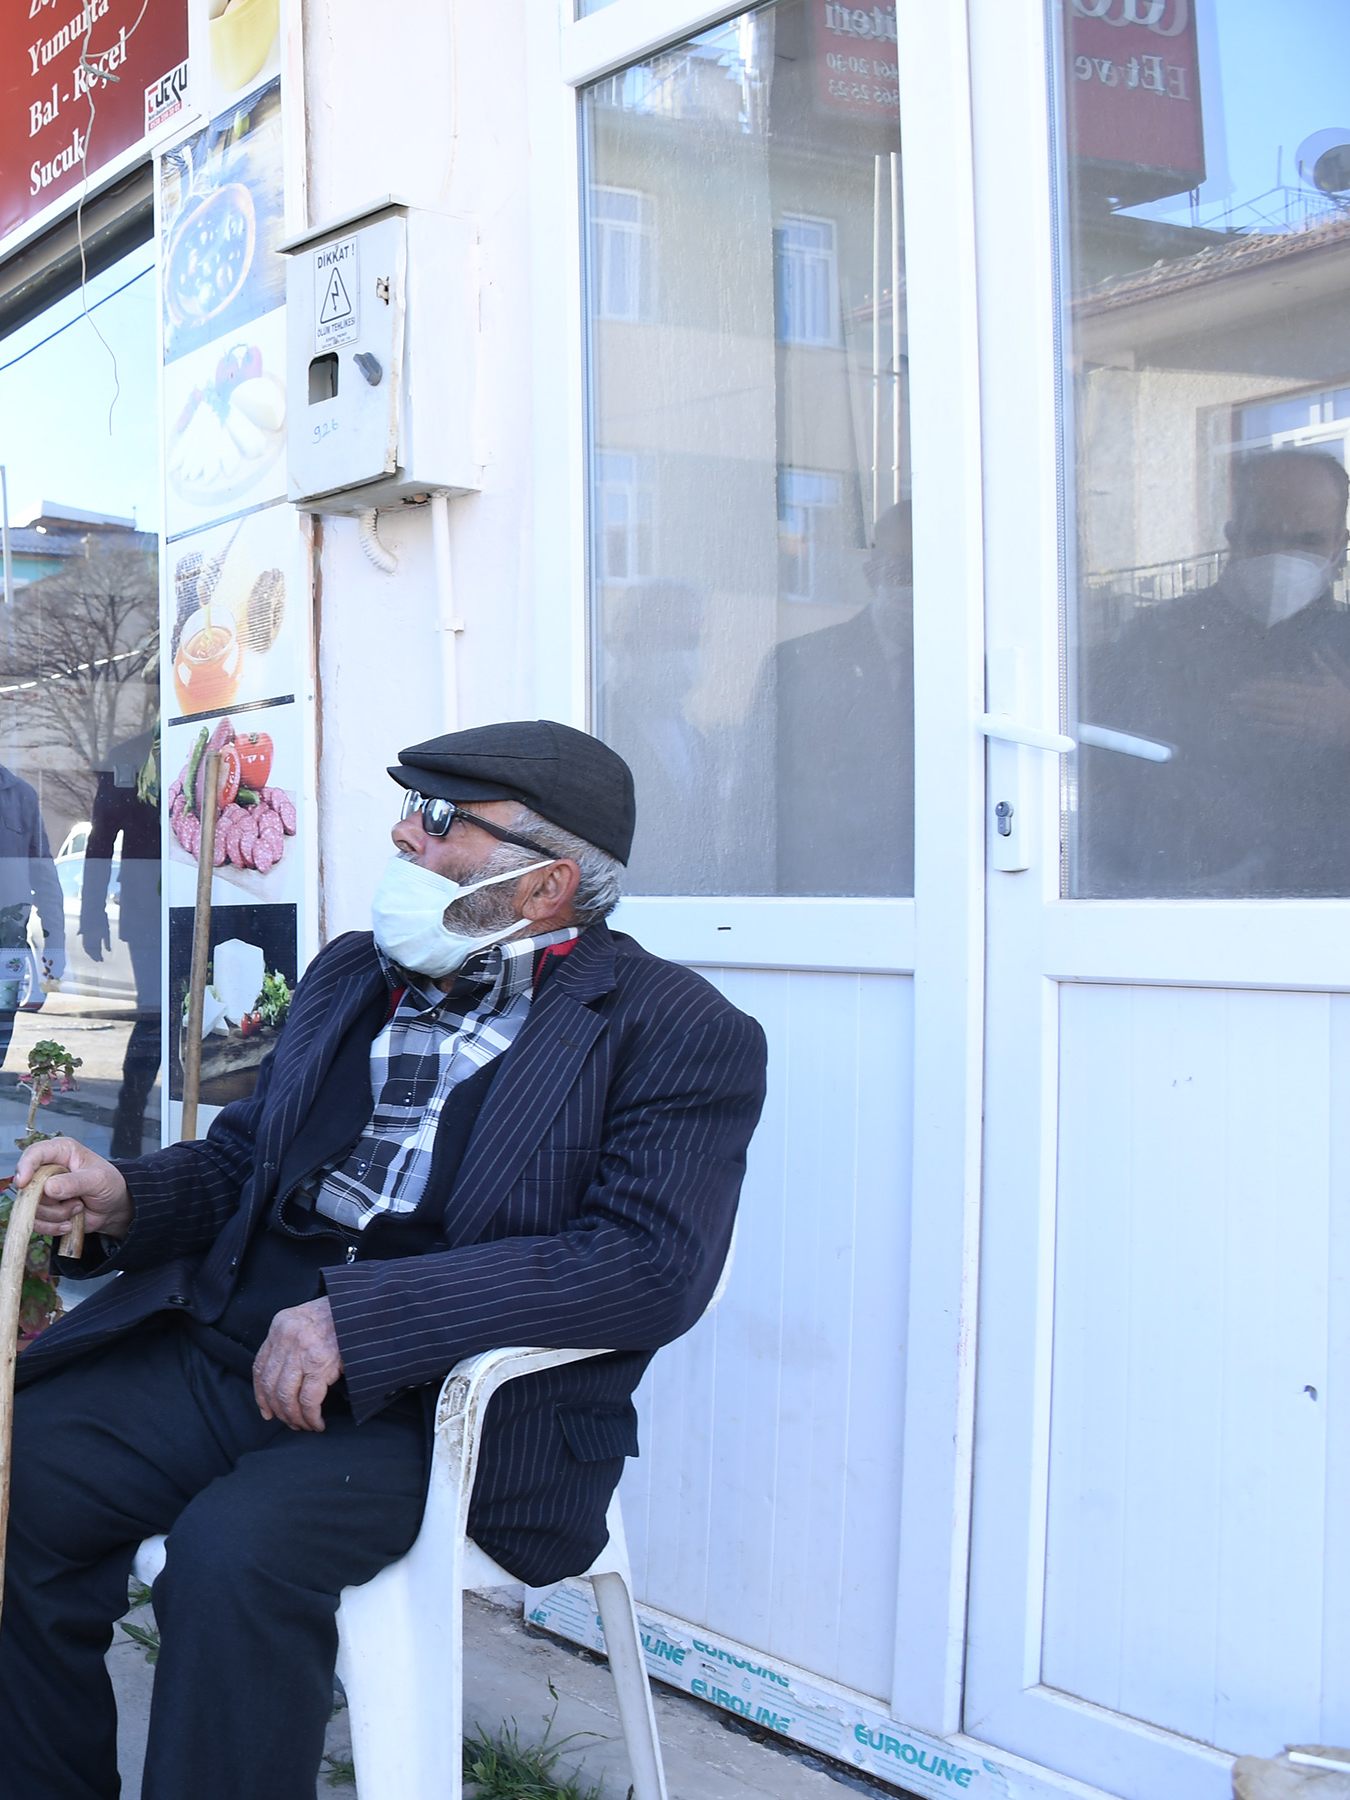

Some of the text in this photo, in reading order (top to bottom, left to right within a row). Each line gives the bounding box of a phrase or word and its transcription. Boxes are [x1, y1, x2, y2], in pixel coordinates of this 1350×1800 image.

[28, 0, 109, 76] Yumurta
[29, 83, 59, 137] Bal
[73, 26, 127, 101] Reçel
[30, 128, 86, 196] Sucuk
[317, 244, 349, 269] DİKKAT
[311, 418, 338, 444] 926
[691, 1678, 791, 1735] EUROLINE
[854, 1723, 973, 1789] EUROLINE
